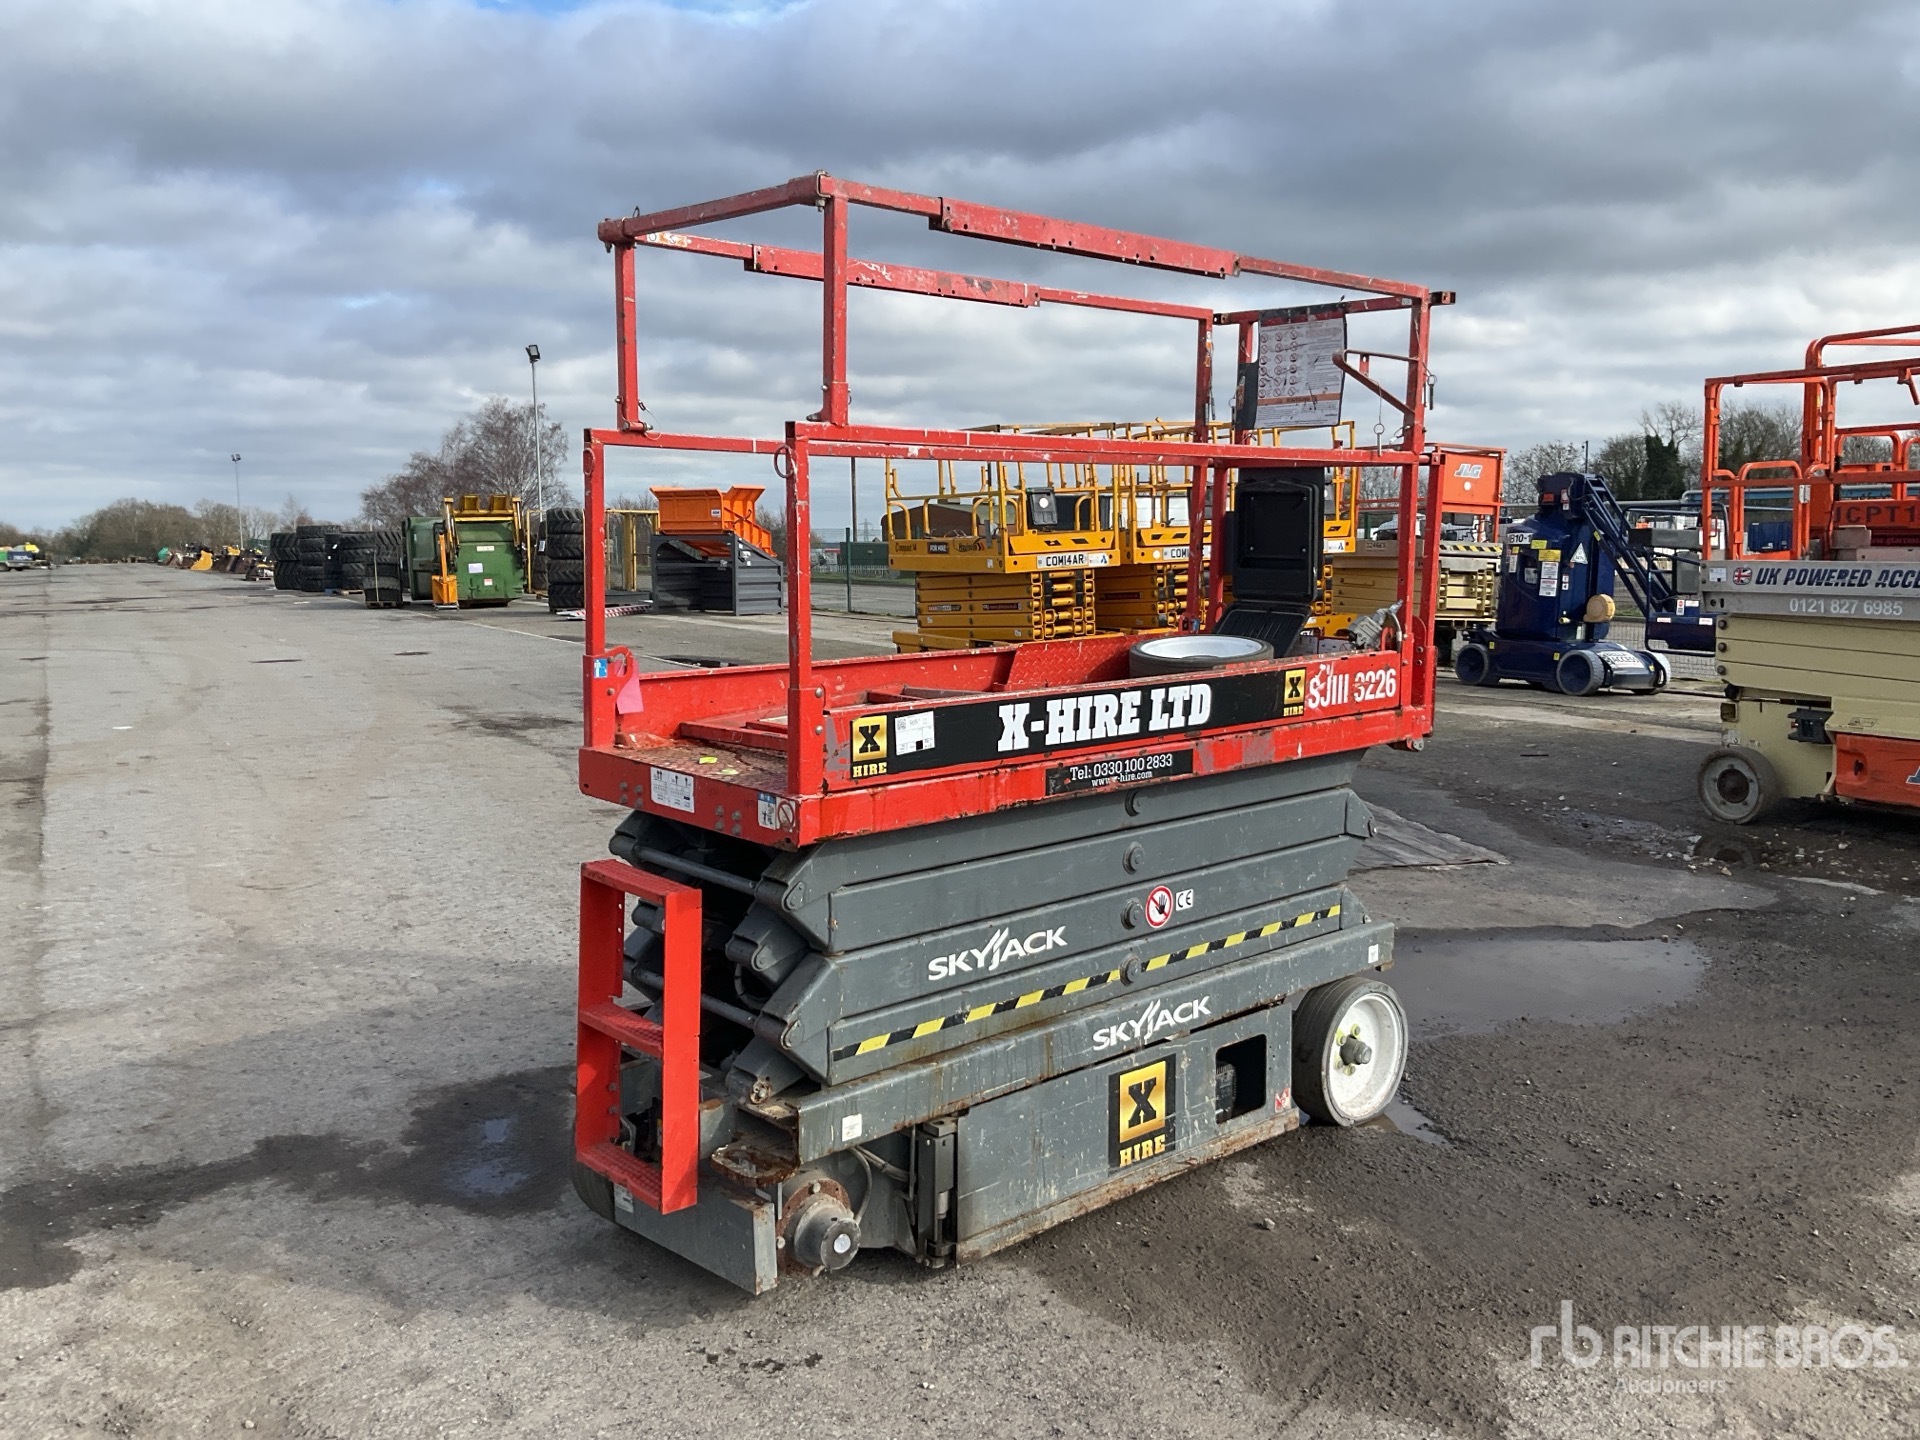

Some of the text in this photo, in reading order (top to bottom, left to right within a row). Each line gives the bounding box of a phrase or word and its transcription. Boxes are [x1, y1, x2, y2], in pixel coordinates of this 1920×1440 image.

[1454, 463, 1483, 478] JLG
[1755, 567, 1783, 585] UK
[1783, 567, 1872, 588] POWERED
[1789, 599, 1903, 616] 0121 827 6985
[1288, 676, 1302, 698] X
[1353, 668, 1397, 703] 3226
[998, 690, 1142, 752] X-HIRE
[1148, 683, 1213, 732] LTD
[1283, 705, 1304, 716] HIRE
[858, 724, 881, 754] X
[852, 762, 888, 778] HIRE
[1070, 753, 1173, 781] Tel: 0330 100 2833
[928, 926, 1068, 981] SKYJACK
[1092, 995, 1212, 1051] SKYJACK
[1128, 1076, 1157, 1129] X
[1119, 1134, 1166, 1168] HIRE
